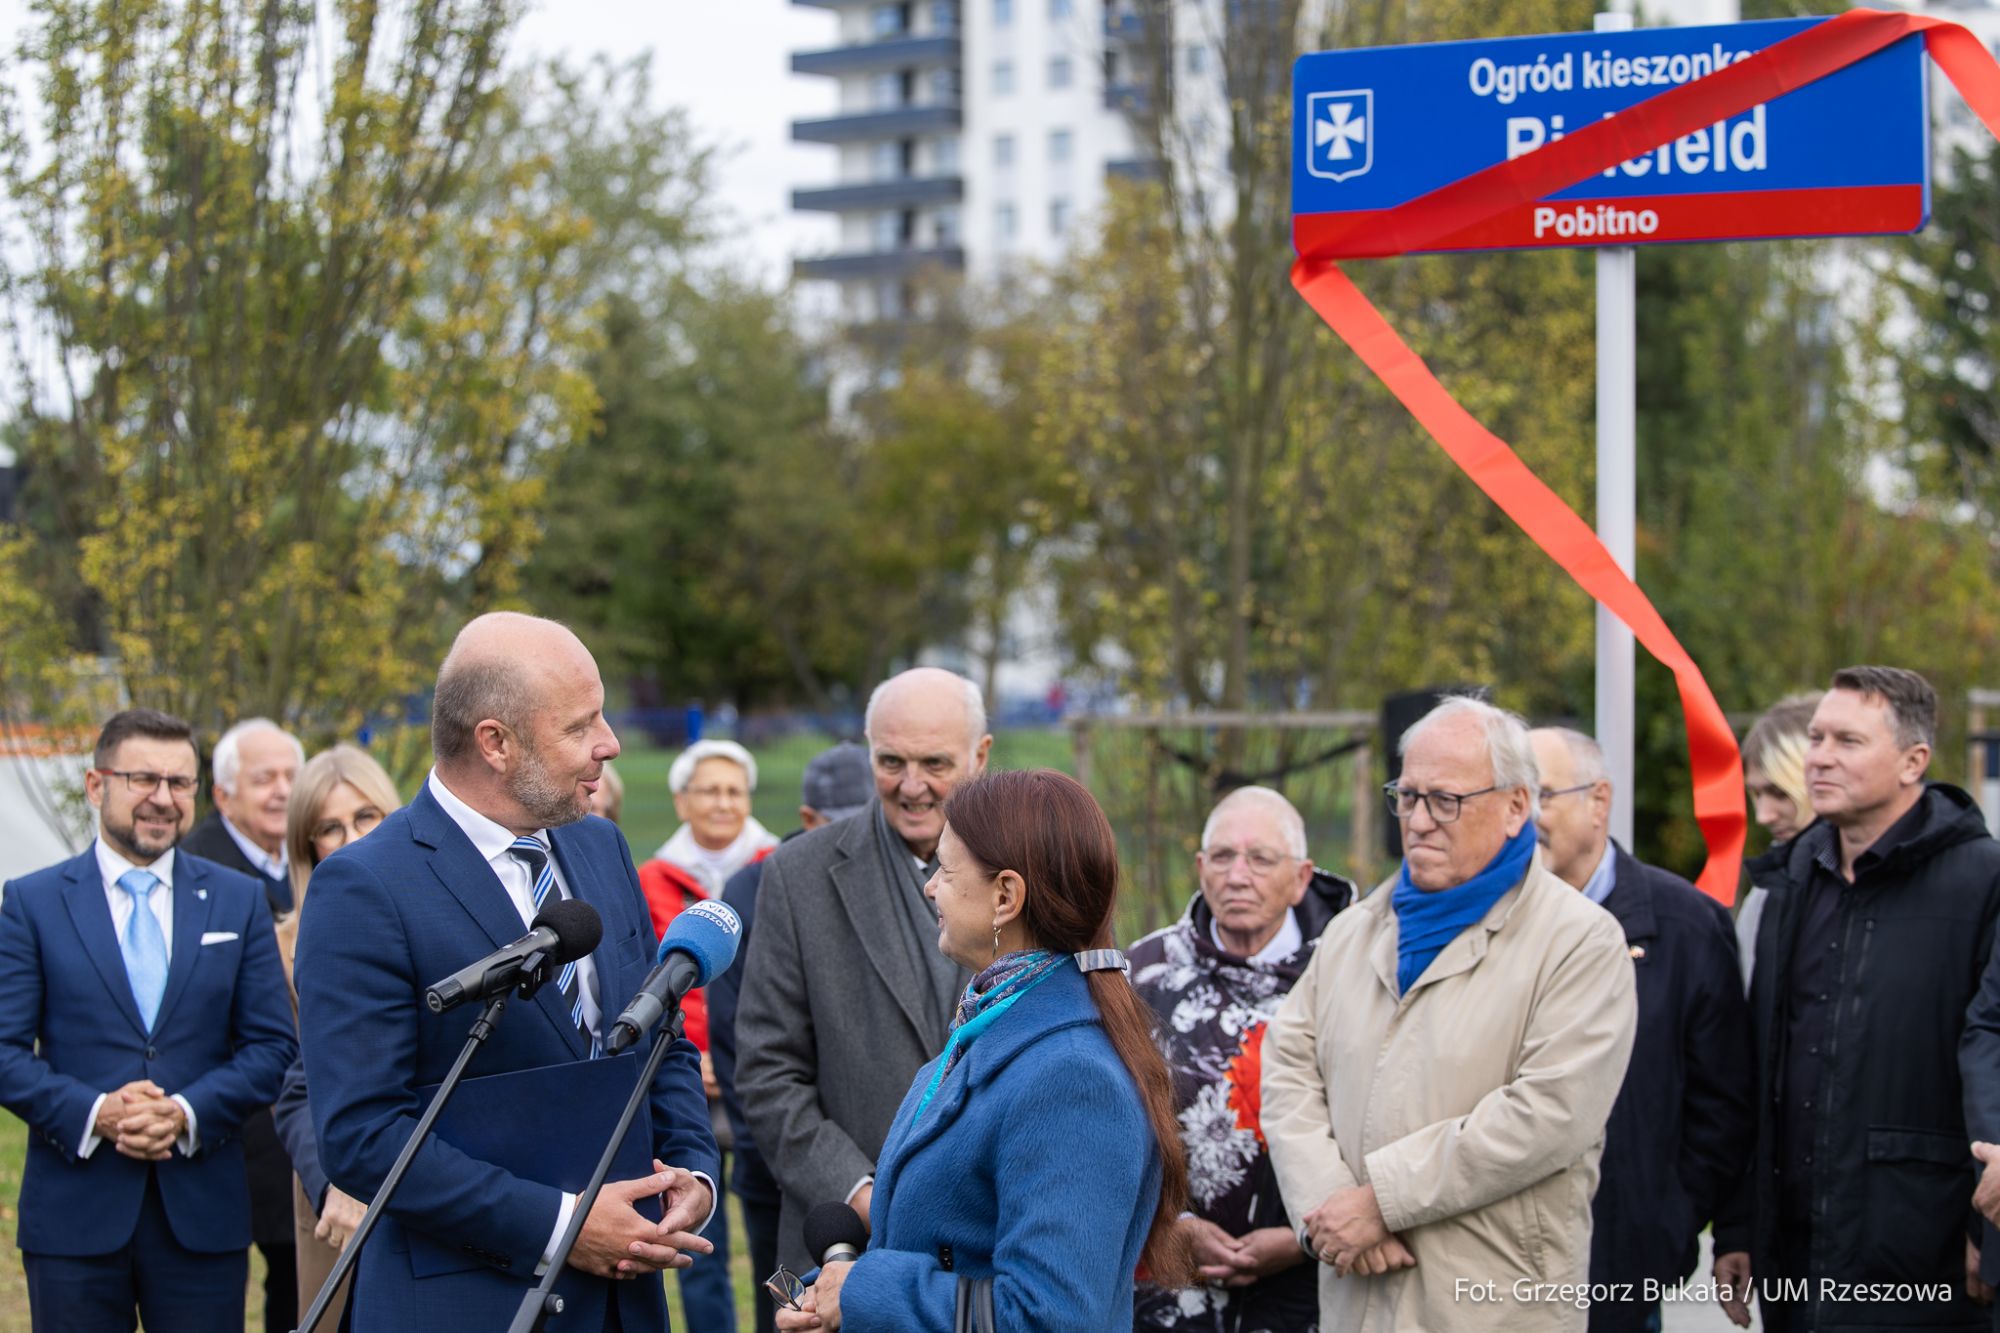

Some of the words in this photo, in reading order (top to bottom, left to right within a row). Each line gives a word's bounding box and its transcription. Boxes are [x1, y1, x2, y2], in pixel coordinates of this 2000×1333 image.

[1469, 52, 1573, 104] Ogród
[1582, 43, 1760, 89] kieszonk
[1534, 205, 1659, 238] Pobitno
